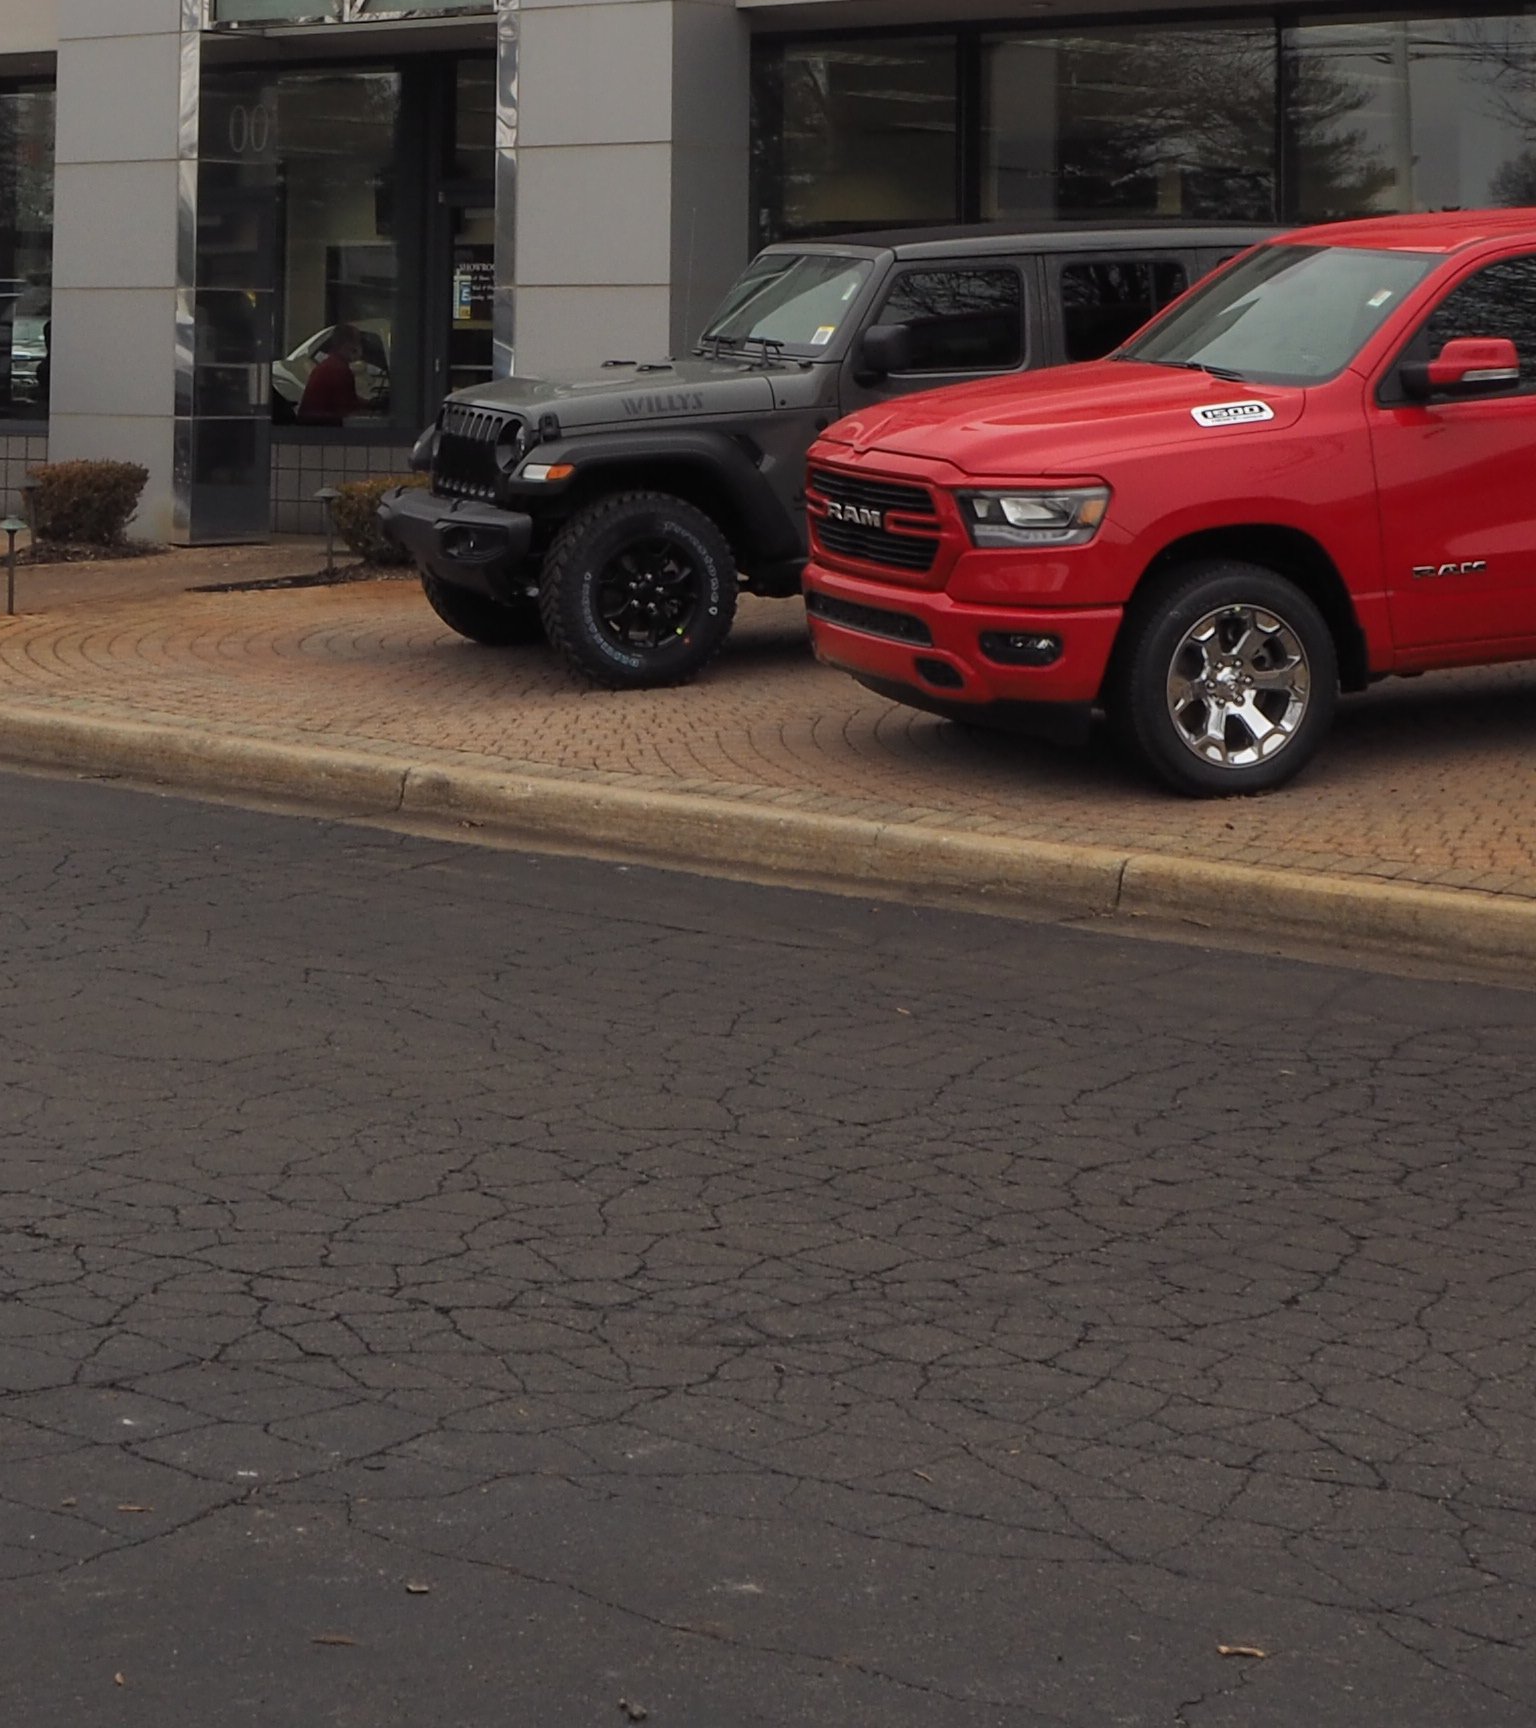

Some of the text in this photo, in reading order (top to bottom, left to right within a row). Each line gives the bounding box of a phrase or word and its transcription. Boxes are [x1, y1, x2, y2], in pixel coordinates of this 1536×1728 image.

[621, 391, 704, 416] WILLYS
[1203, 404, 1264, 420] 1500
[827, 500, 882, 529] RAM
